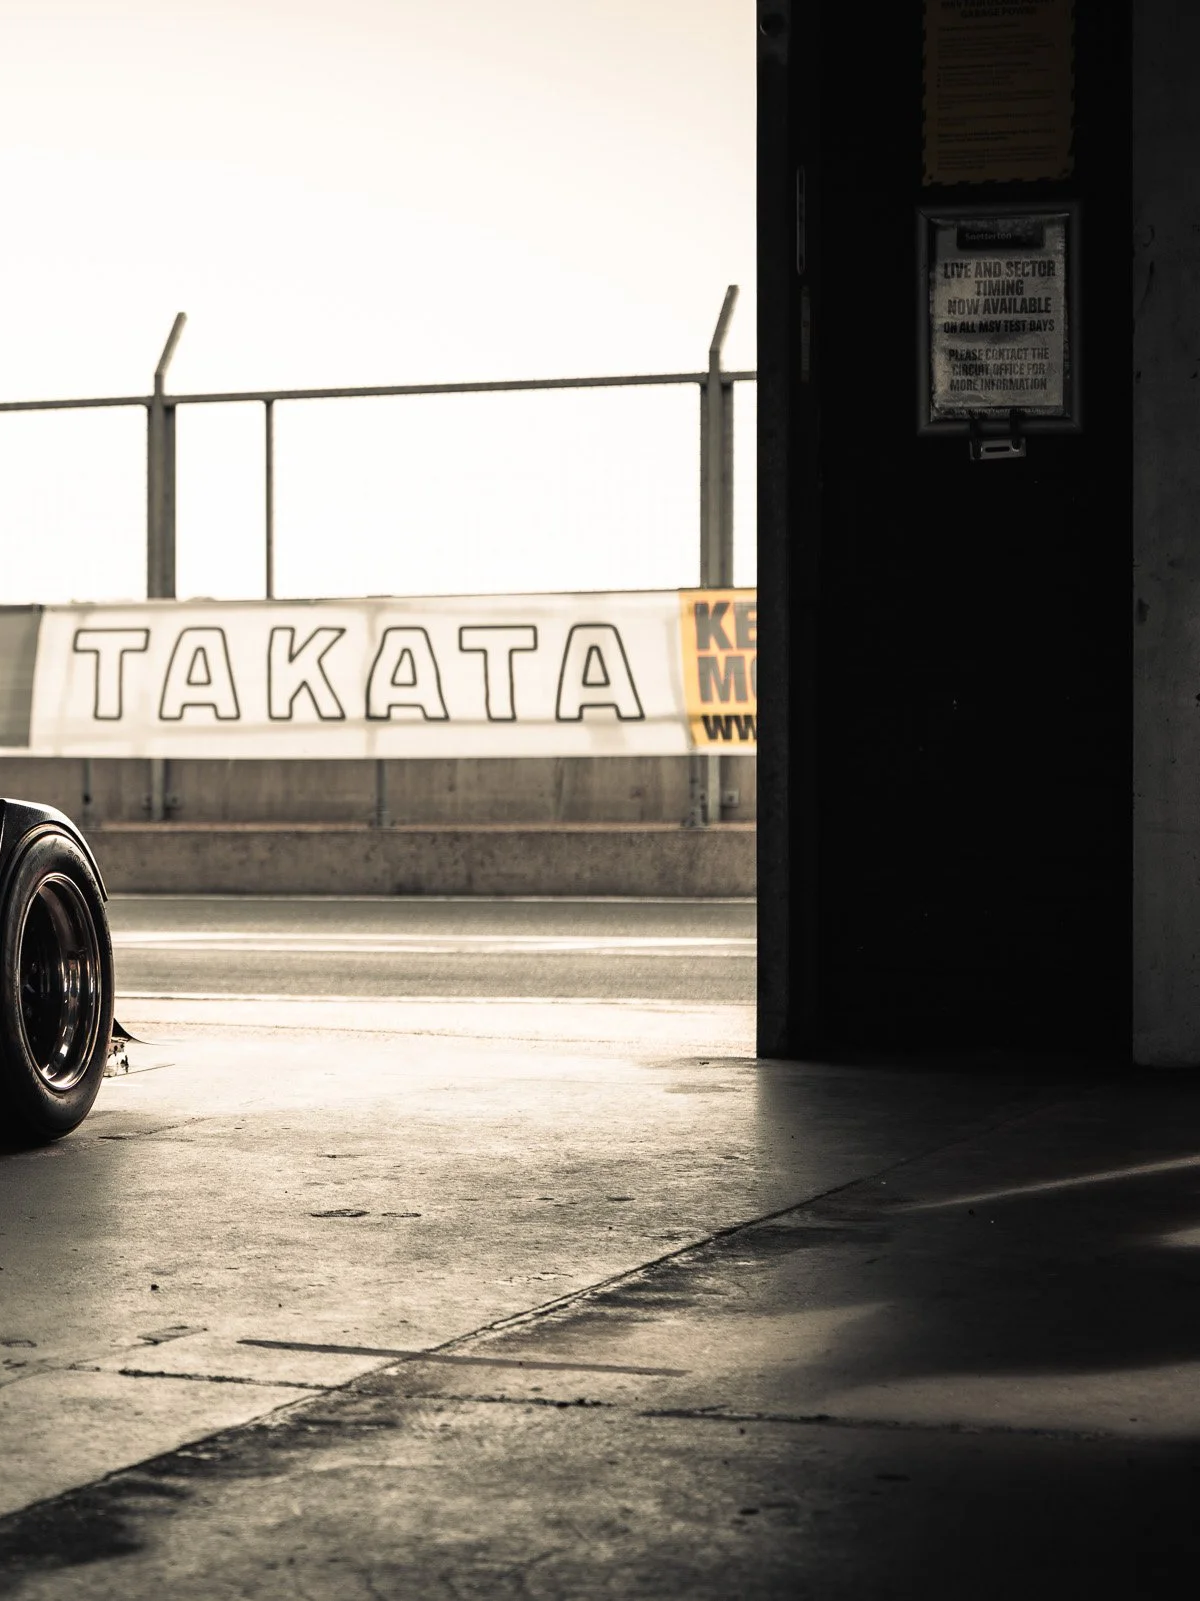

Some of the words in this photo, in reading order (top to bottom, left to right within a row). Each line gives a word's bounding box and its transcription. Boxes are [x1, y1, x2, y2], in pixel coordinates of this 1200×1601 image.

[943, 262, 972, 279] LIVE
[974, 261, 1002, 278] AND
[1005, 260, 1056, 277] SECTOR
[975, 280, 1024, 296] TIMING
[947, 298, 979, 315] NOW
[982, 297, 1052, 315] AVAILABLE
[943, 322, 958, 334] ON
[959, 321, 976, 333] ALL
[978, 321, 1001, 333] MSV
[1003, 320, 1027, 332] TEST
[1029, 319, 1055, 332] DAYS
[948, 348, 983, 361] PLEASE
[984, 348, 1030, 360] CONTACT
[1031, 347, 1050, 359] THE
[951, 363, 990, 376] CIRCUIT
[992, 362, 1025, 375] OFFICE
[1026, 362, 1046, 374] FOR
[949, 379, 978, 391] MORE
[980, 377, 1047, 391] INFORMATION
[73, 623, 646, 721] TAKATA
